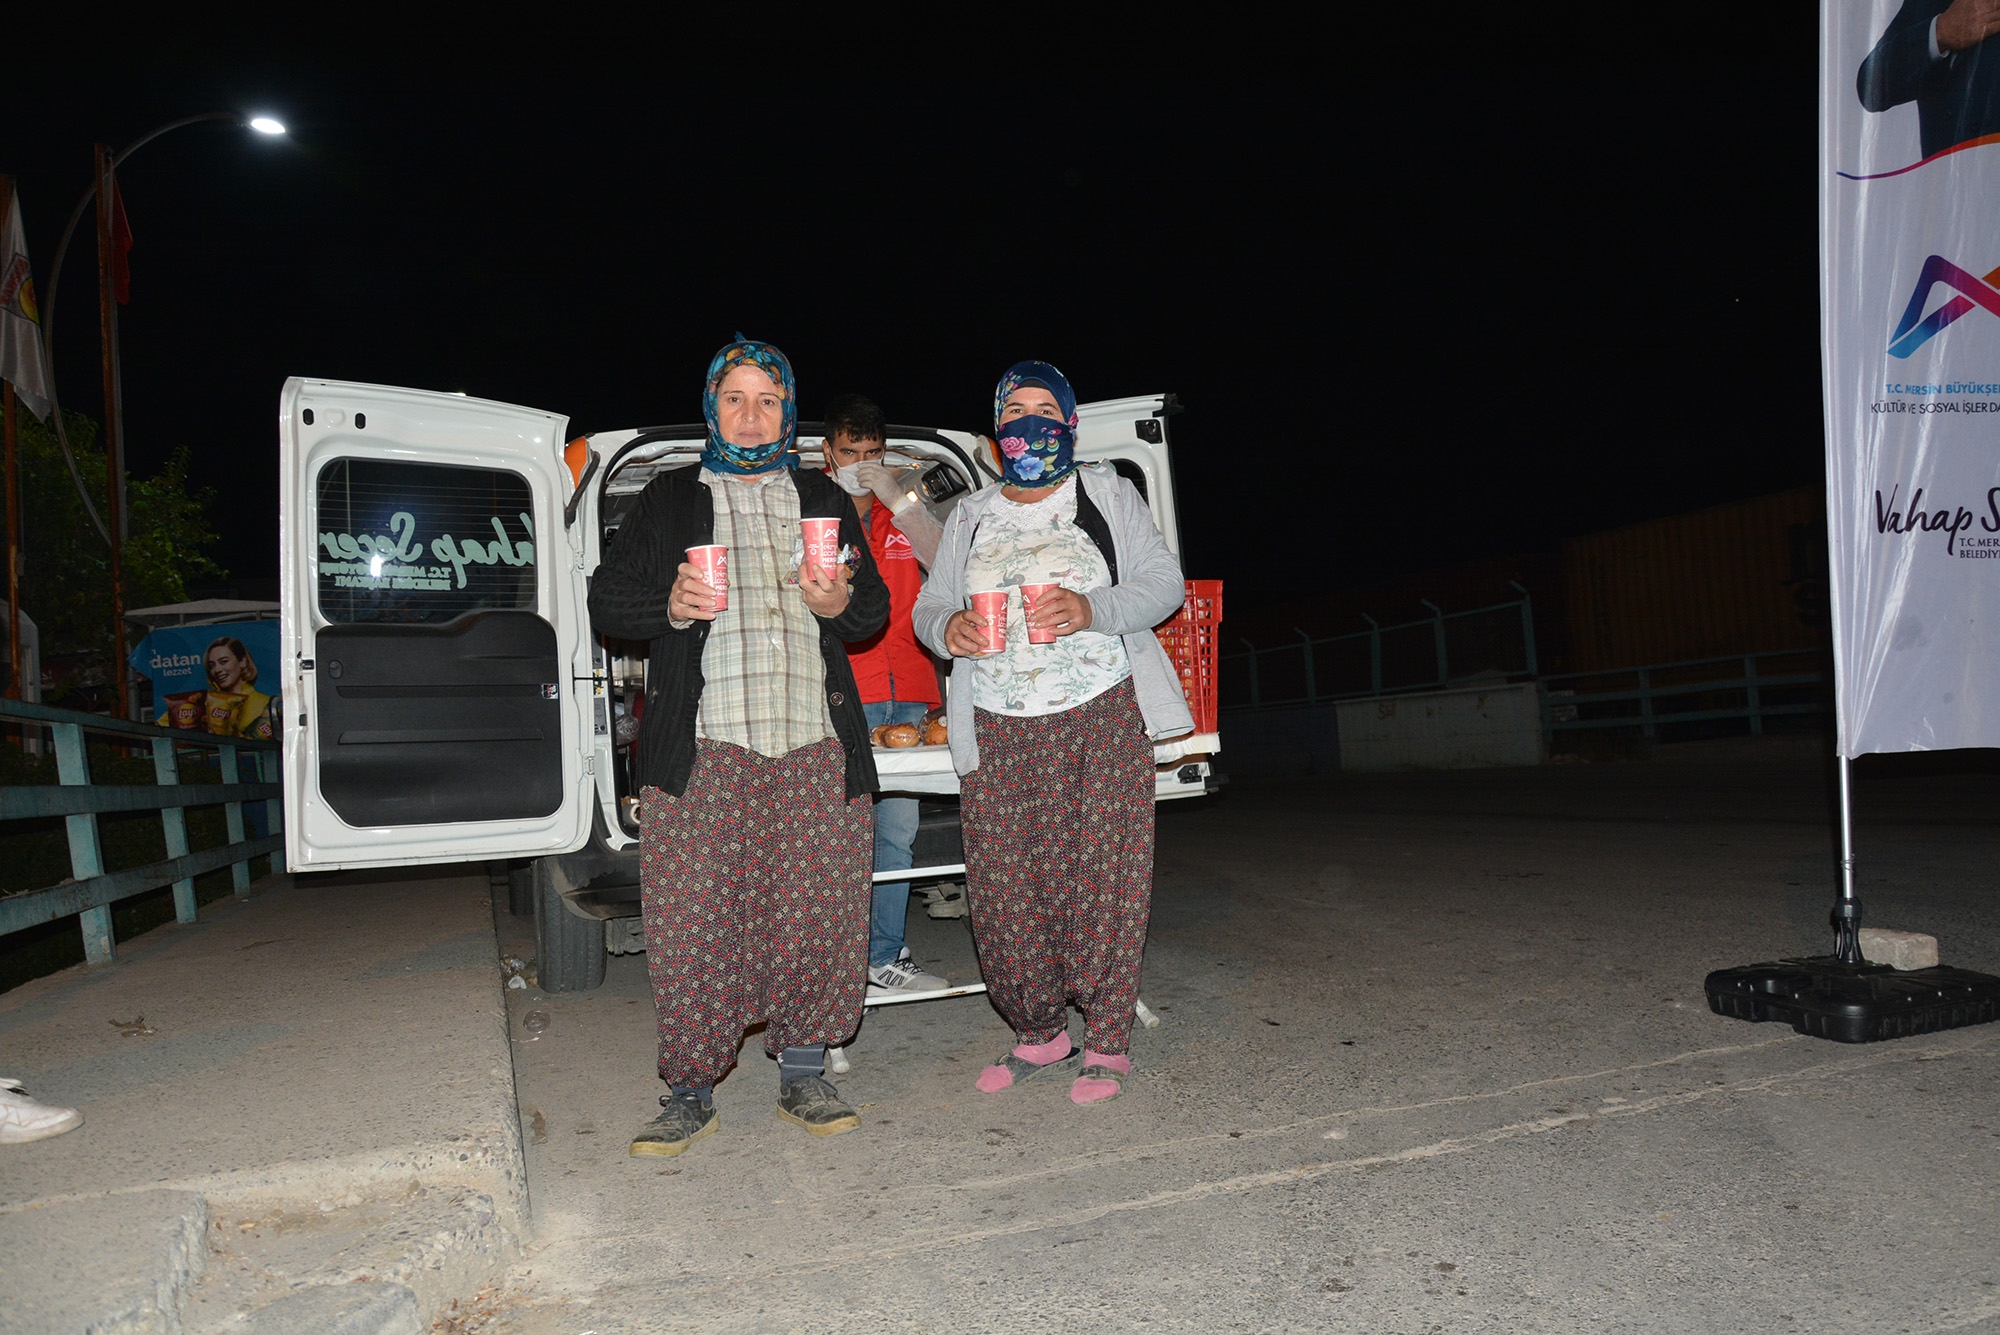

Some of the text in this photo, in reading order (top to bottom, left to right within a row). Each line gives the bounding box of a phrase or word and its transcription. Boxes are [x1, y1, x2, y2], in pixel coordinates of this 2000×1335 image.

[1905, 383, 1942, 395] MERSİN
[1946, 381, 2000, 396] BÜYÜKŞE
[1871, 400, 1906, 414] KÜLTÜR
[1907, 403, 1916, 414] VE
[1919, 402, 1960, 414] SOSYAL
[1962, 400, 1988, 415] İŞLER
[1875, 483, 1973, 556] Vahap
[1960, 548, 2000, 559] BELEDİY
[151, 653, 201, 669] datan
[163, 667, 192, 677] lezzet
